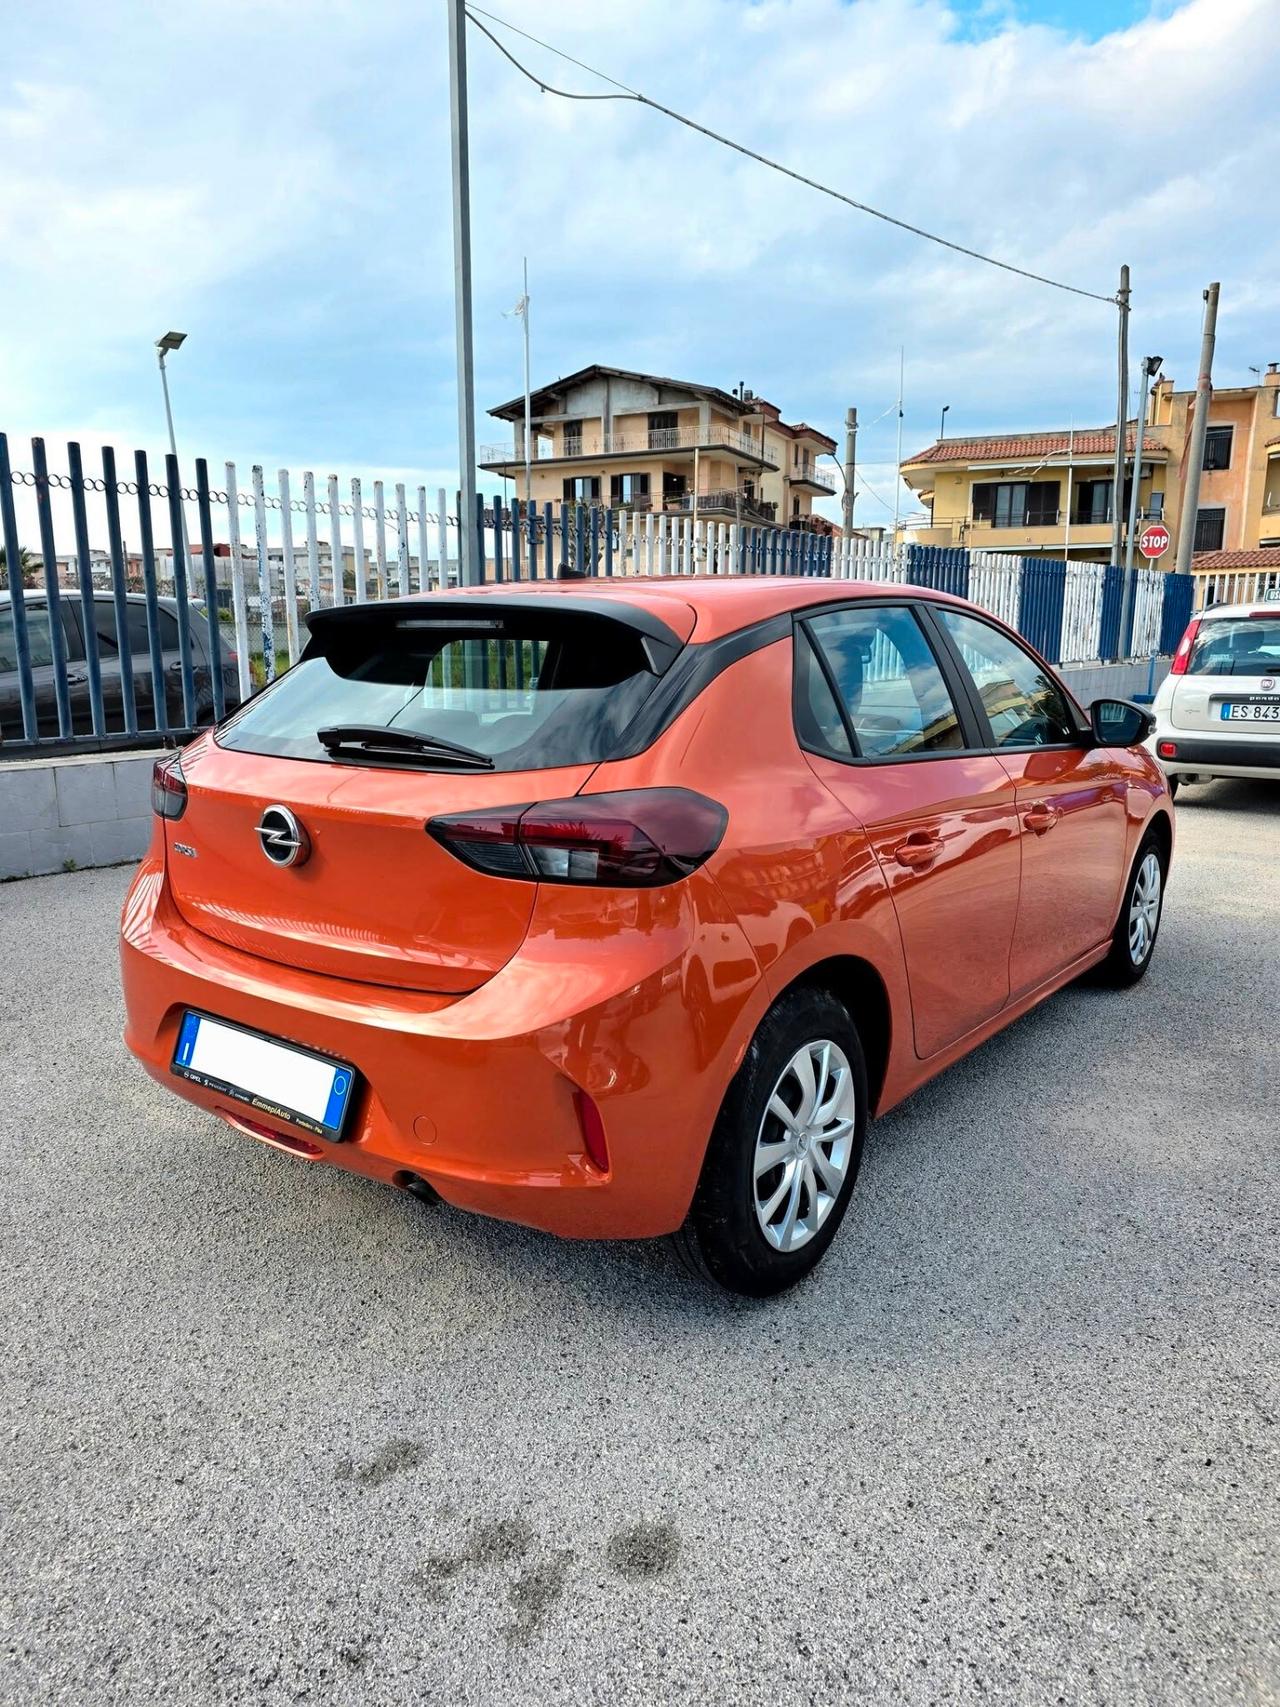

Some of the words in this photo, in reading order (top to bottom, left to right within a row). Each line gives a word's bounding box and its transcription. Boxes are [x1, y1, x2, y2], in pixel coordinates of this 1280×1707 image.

[1142, 535, 1168, 548] STOP
[1232, 705, 1248, 718] ES
[1253, 706, 1280, 719] 843
